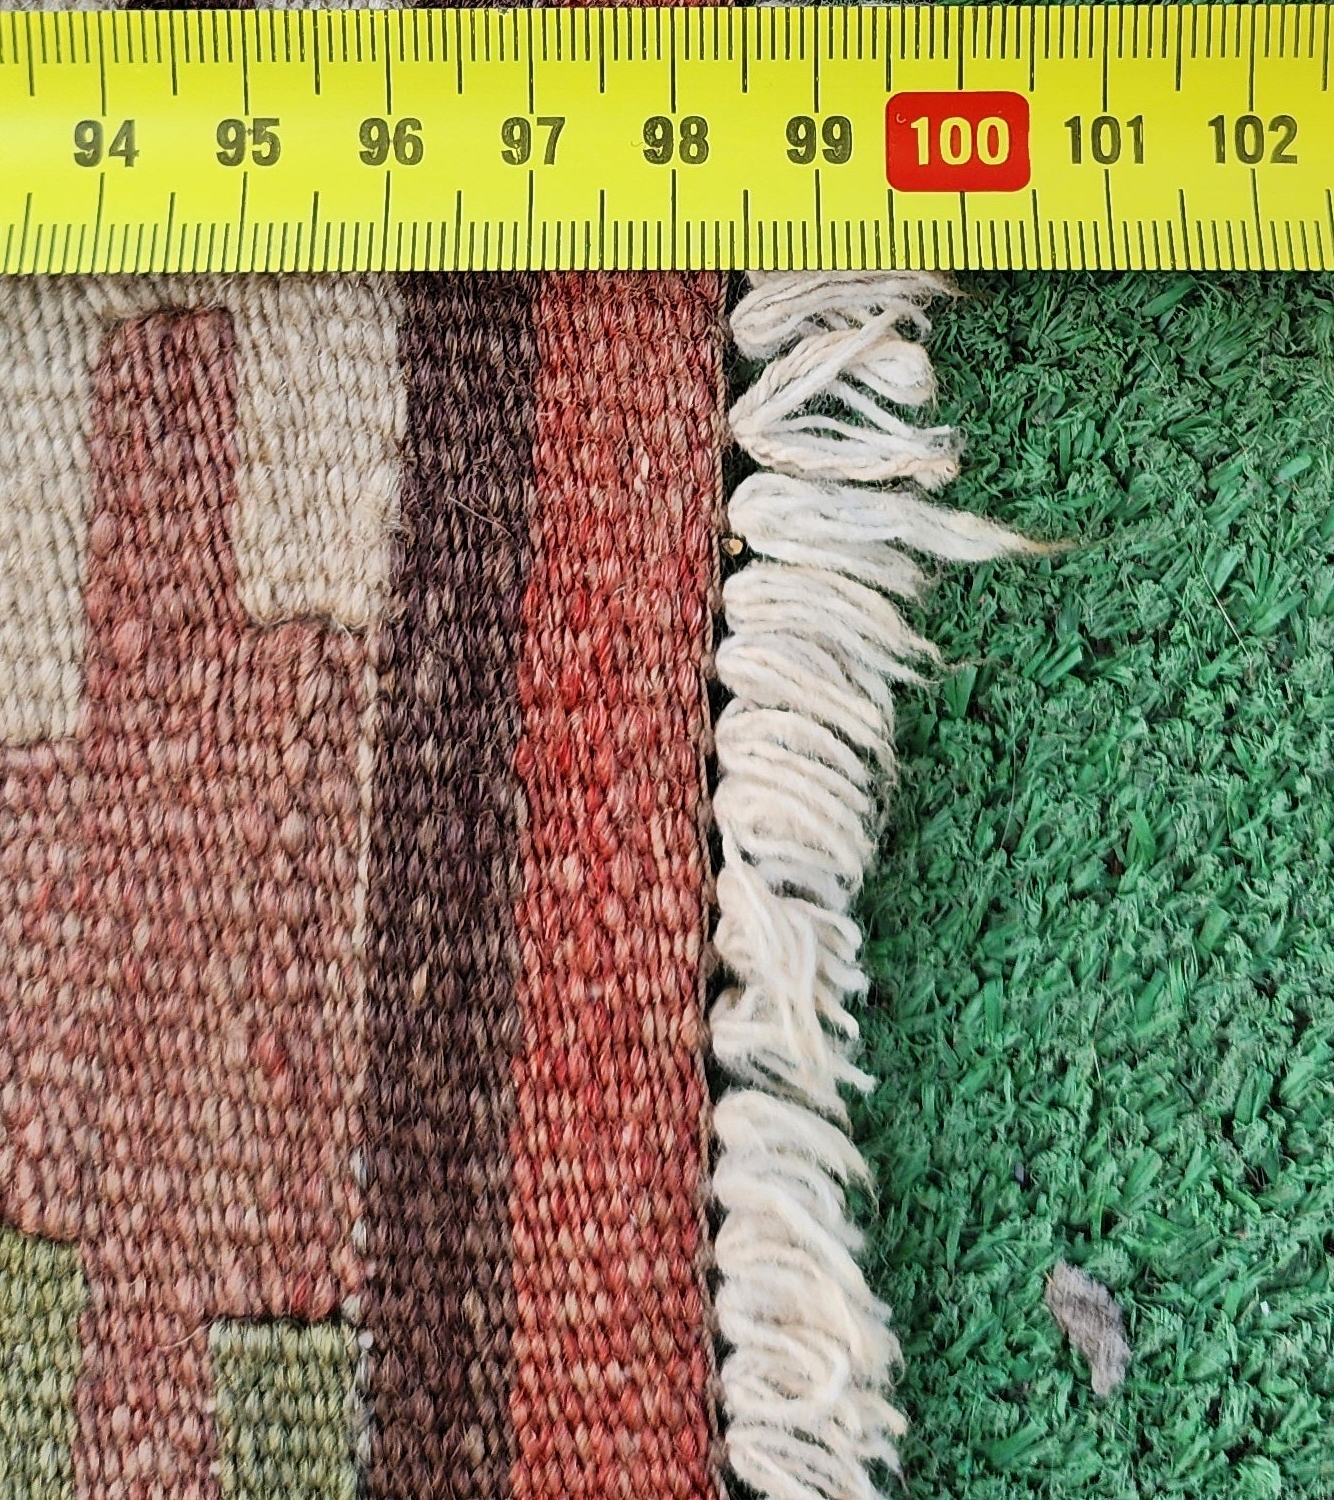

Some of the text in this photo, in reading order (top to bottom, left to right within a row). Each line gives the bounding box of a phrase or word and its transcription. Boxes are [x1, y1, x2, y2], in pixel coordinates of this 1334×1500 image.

[73, 119, 140, 169] 94
[216, 118, 281, 168] 95
[359, 117, 424, 167] 96
[501, 116, 565, 166] 97
[643, 116, 709, 166] 98
[786, 115, 852, 165] 99
[910, 116, 1009, 166] 100
[1064, 115, 1144, 165] 101
[1208, 115, 1298, 165] 102
